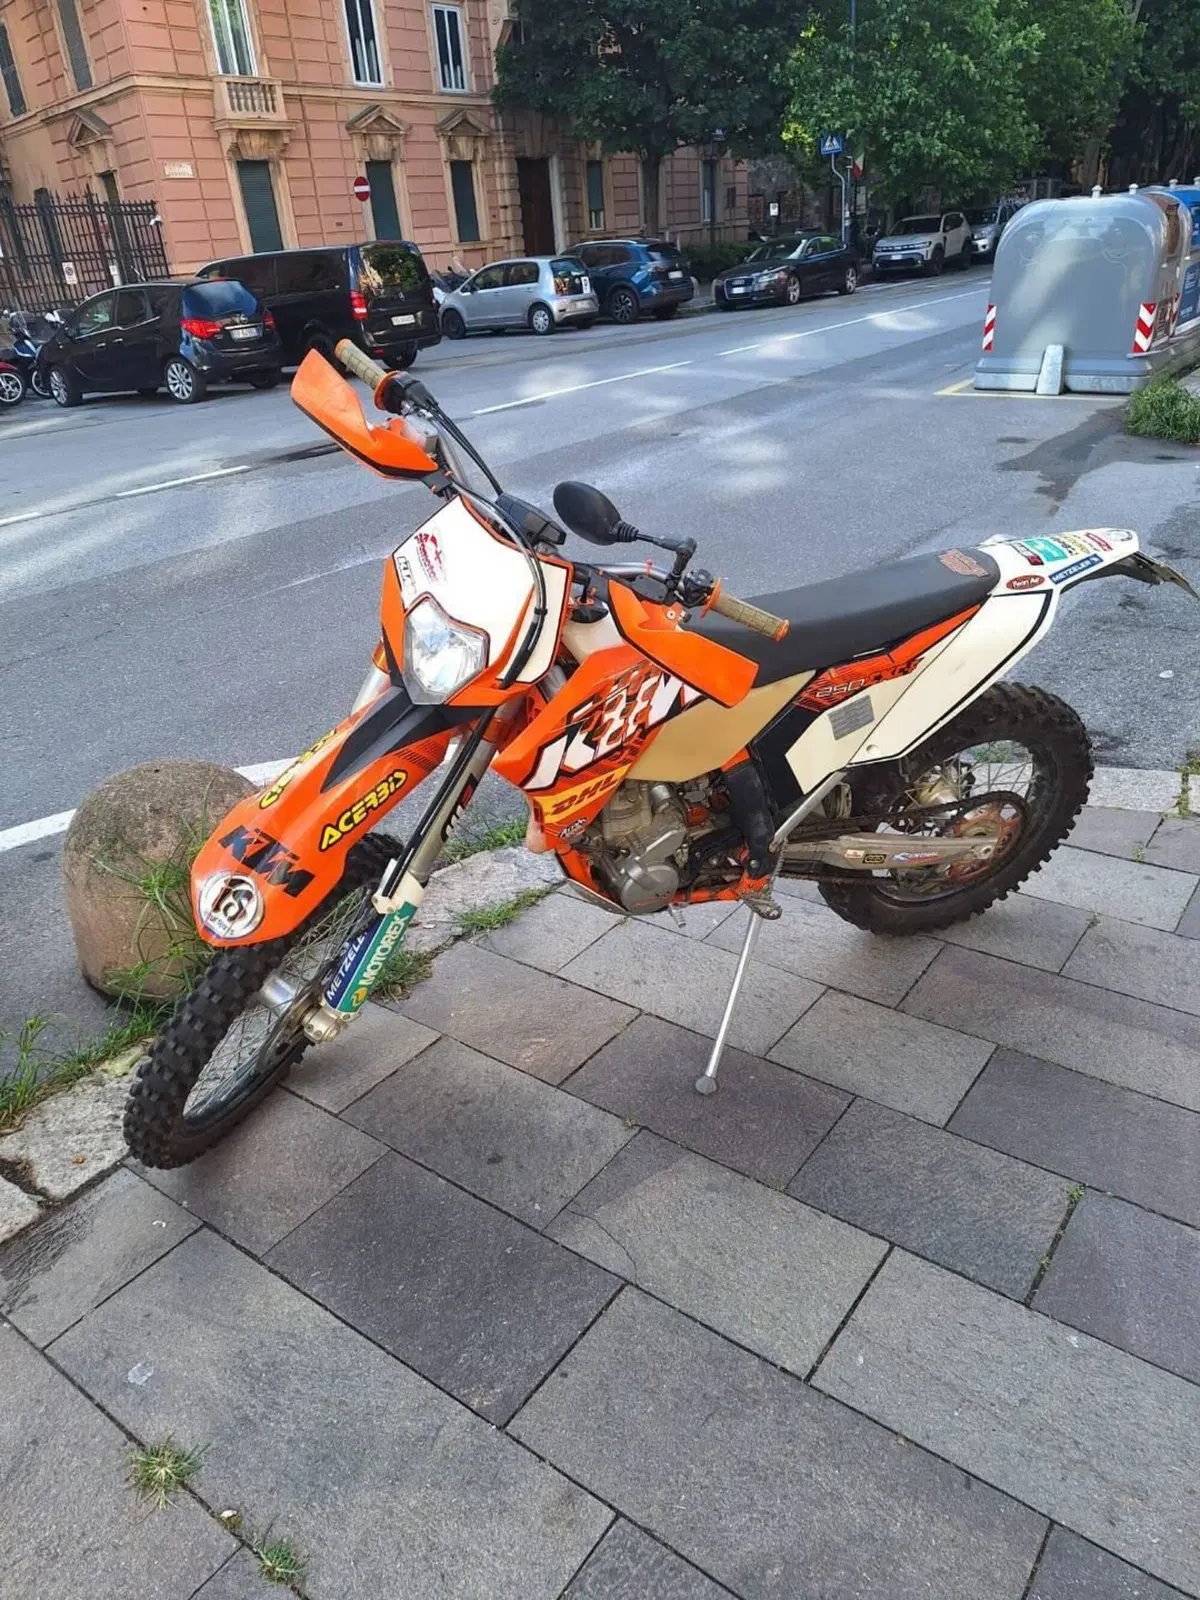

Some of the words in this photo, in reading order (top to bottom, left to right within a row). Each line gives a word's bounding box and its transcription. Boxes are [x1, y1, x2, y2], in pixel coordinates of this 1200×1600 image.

[318, 769, 408, 851] ACERBIS
[550, 774, 619, 816] DHL
[217, 824, 316, 898] KTM
[357, 914, 410, 986] MOTOREX
